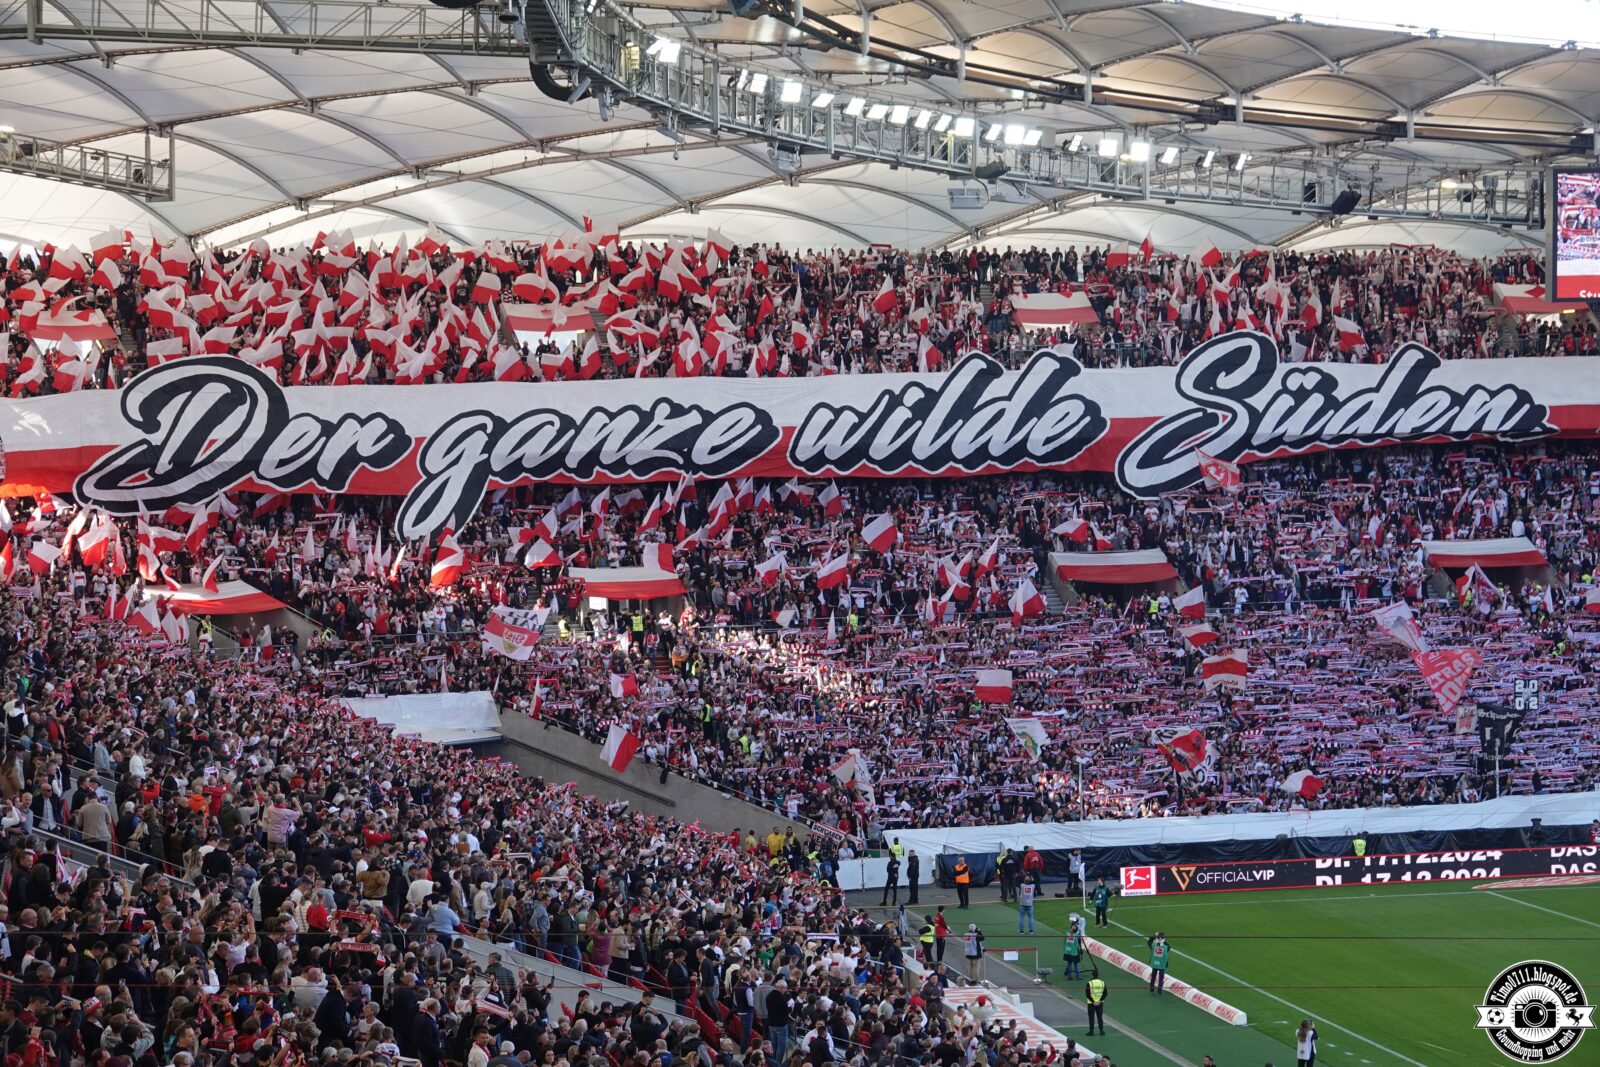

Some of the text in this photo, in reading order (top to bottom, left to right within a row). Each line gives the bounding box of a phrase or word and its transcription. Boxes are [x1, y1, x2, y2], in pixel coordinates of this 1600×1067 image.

[75, 330, 1560, 541] Der ganze wilde Süden
